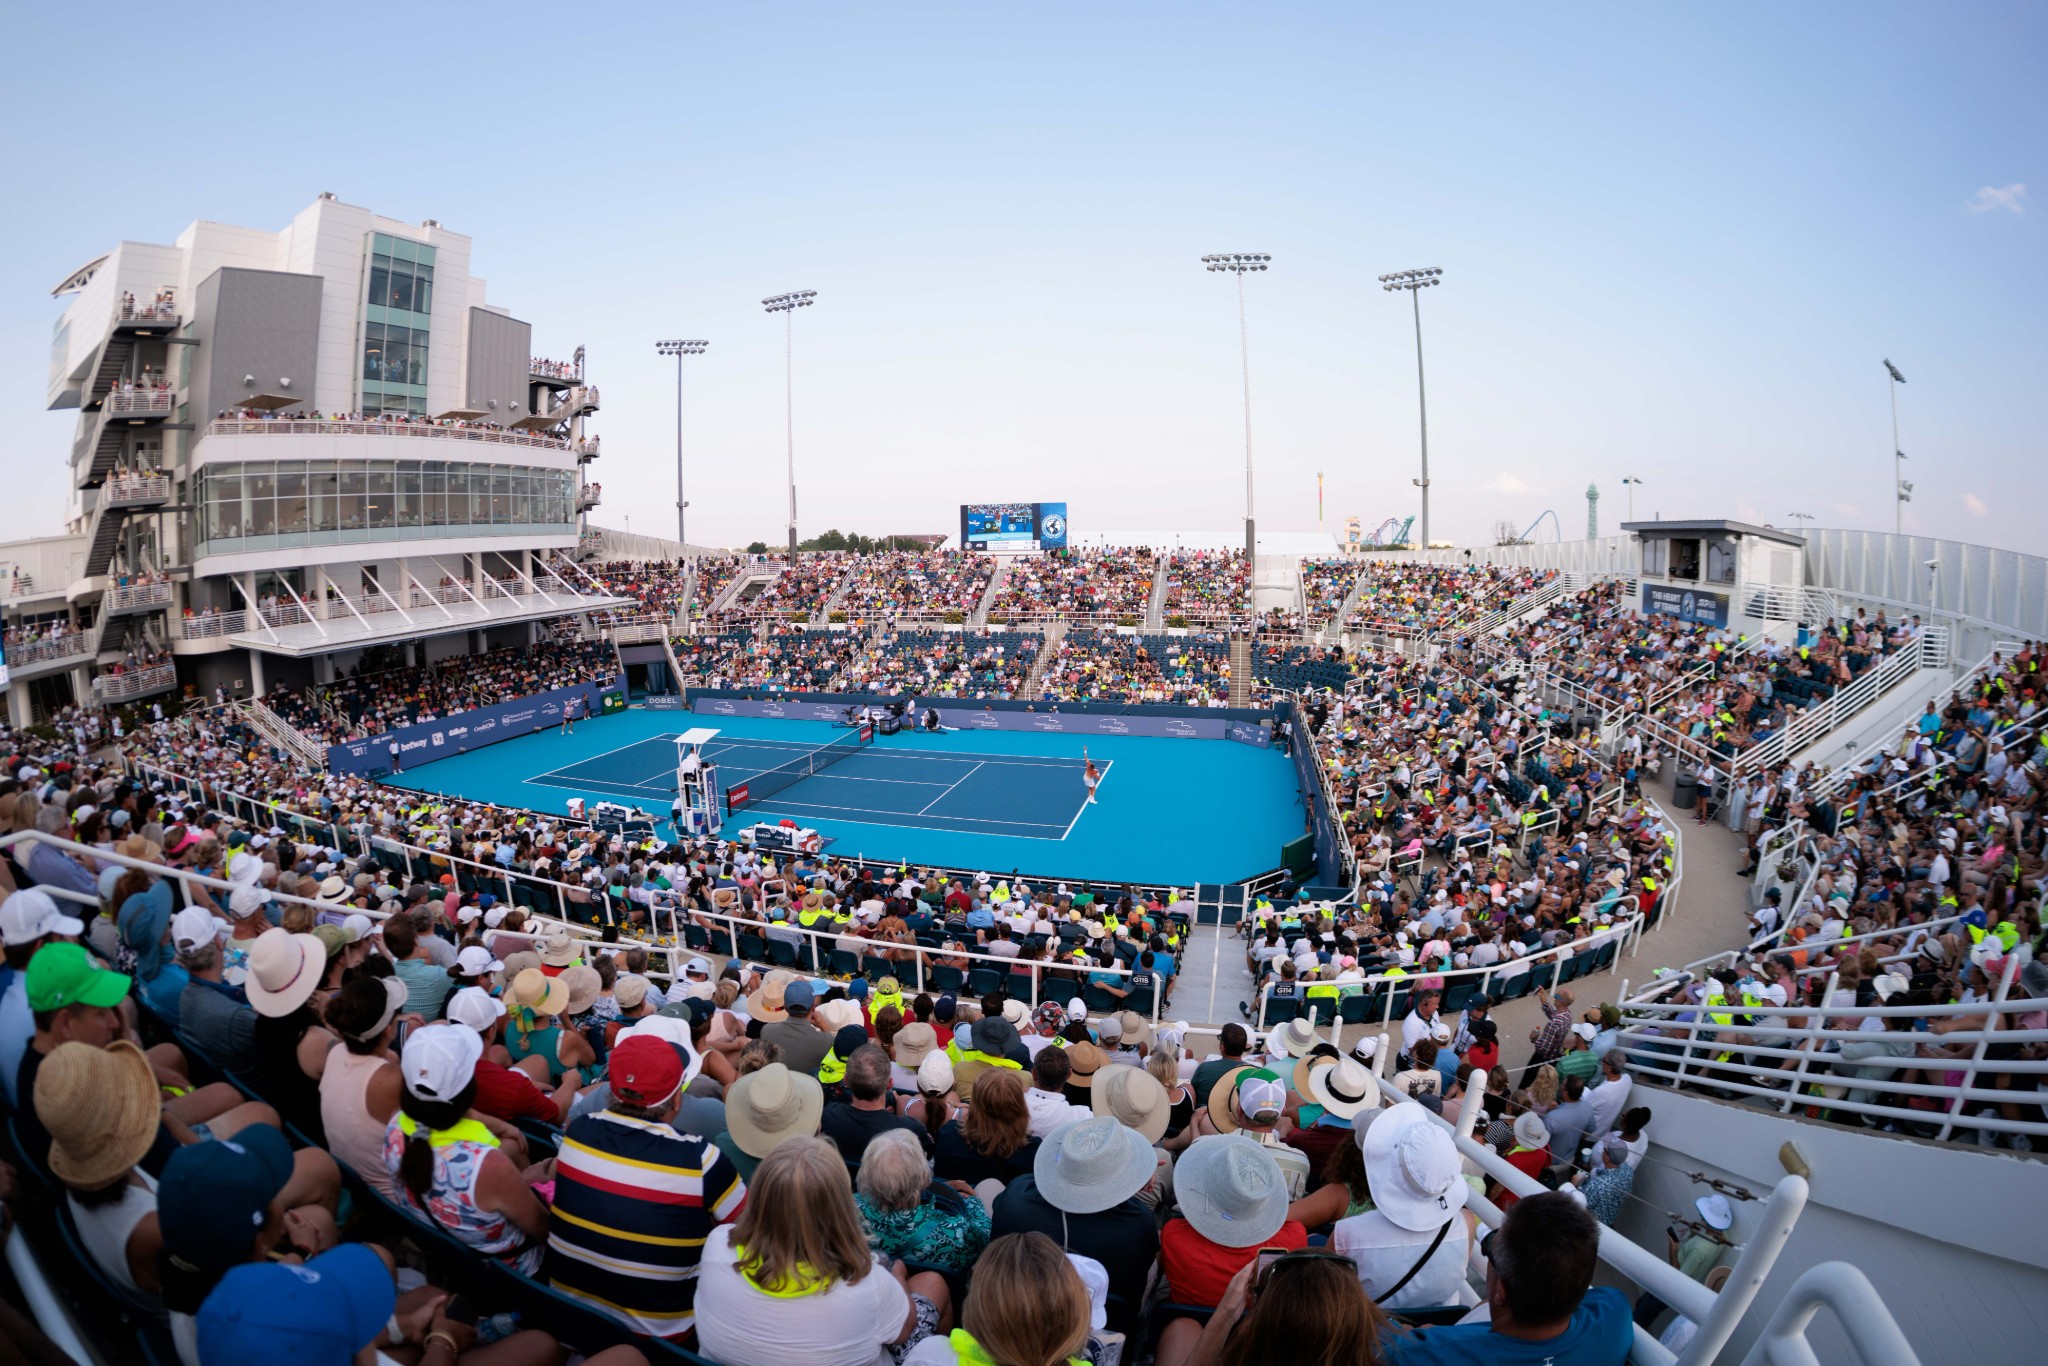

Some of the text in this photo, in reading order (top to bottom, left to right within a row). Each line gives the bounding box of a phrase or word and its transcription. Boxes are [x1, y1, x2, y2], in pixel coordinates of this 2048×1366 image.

[1652, 591, 1681, 603] THE HEART
[1654, 601, 1680, 613] OF TENNIS
[400, 738, 428, 752] betway
[352, 746, 364, 757] 121
[730, 789, 748, 803] Emirates
[1132, 976, 1149, 984] G115
